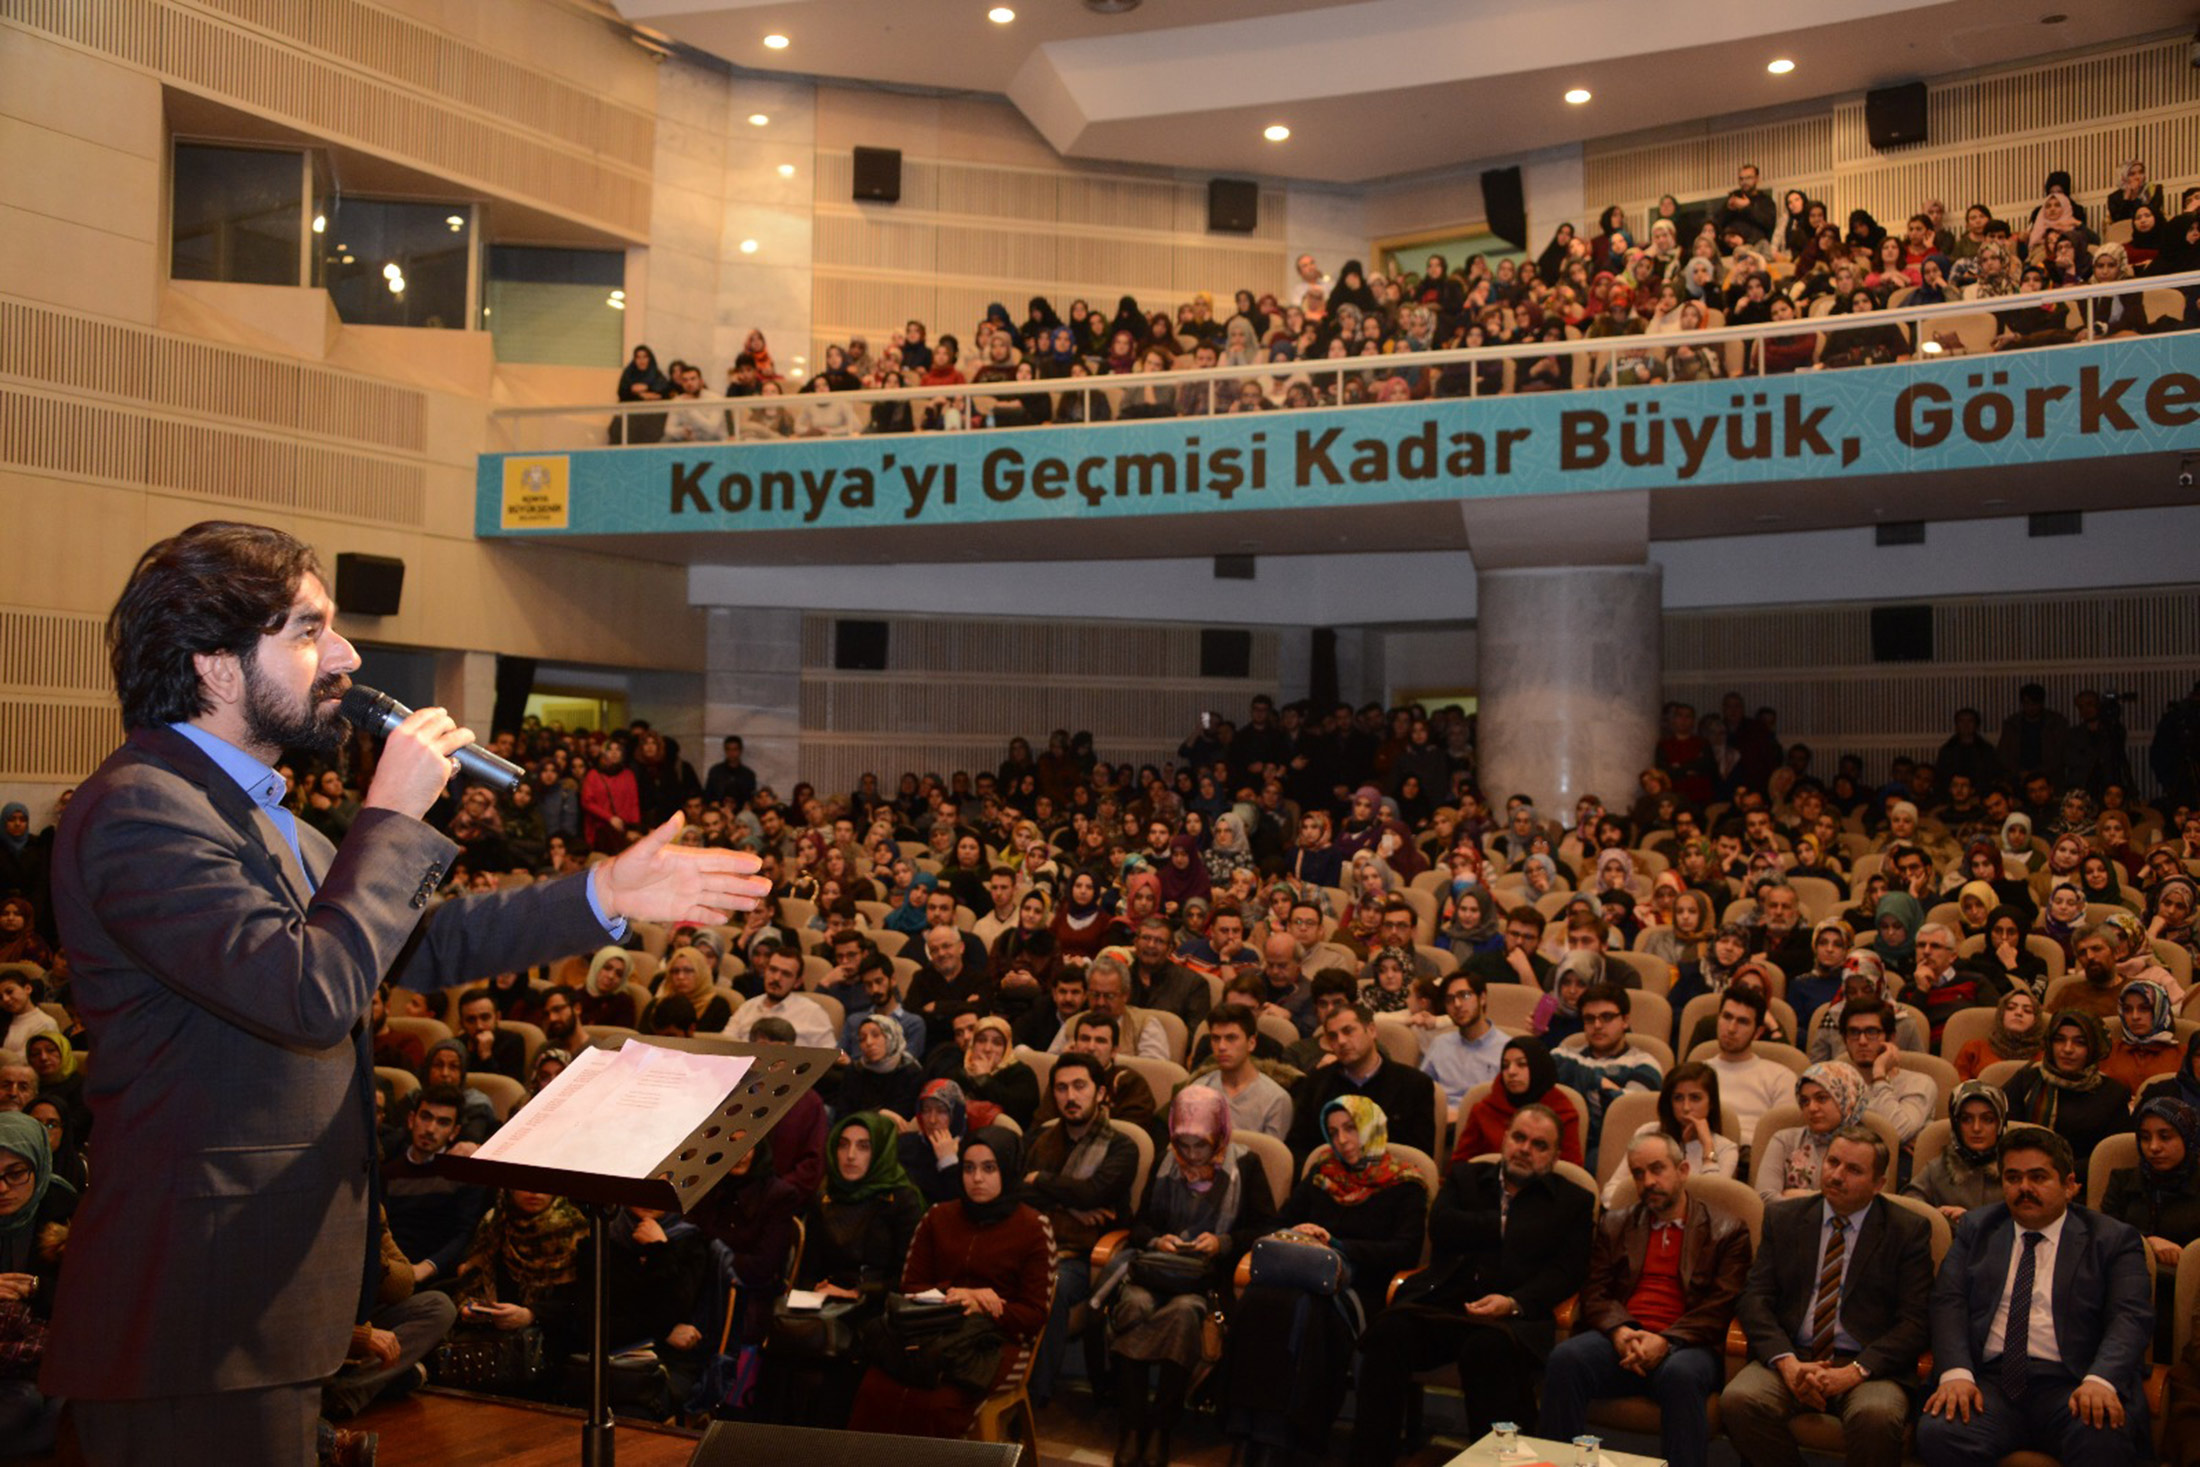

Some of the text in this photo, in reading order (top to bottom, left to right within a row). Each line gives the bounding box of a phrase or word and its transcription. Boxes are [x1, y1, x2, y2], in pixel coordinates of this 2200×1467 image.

[669, 364, 2200, 524] Konya'yı Geçmişi Kadar Büyük, Görke
